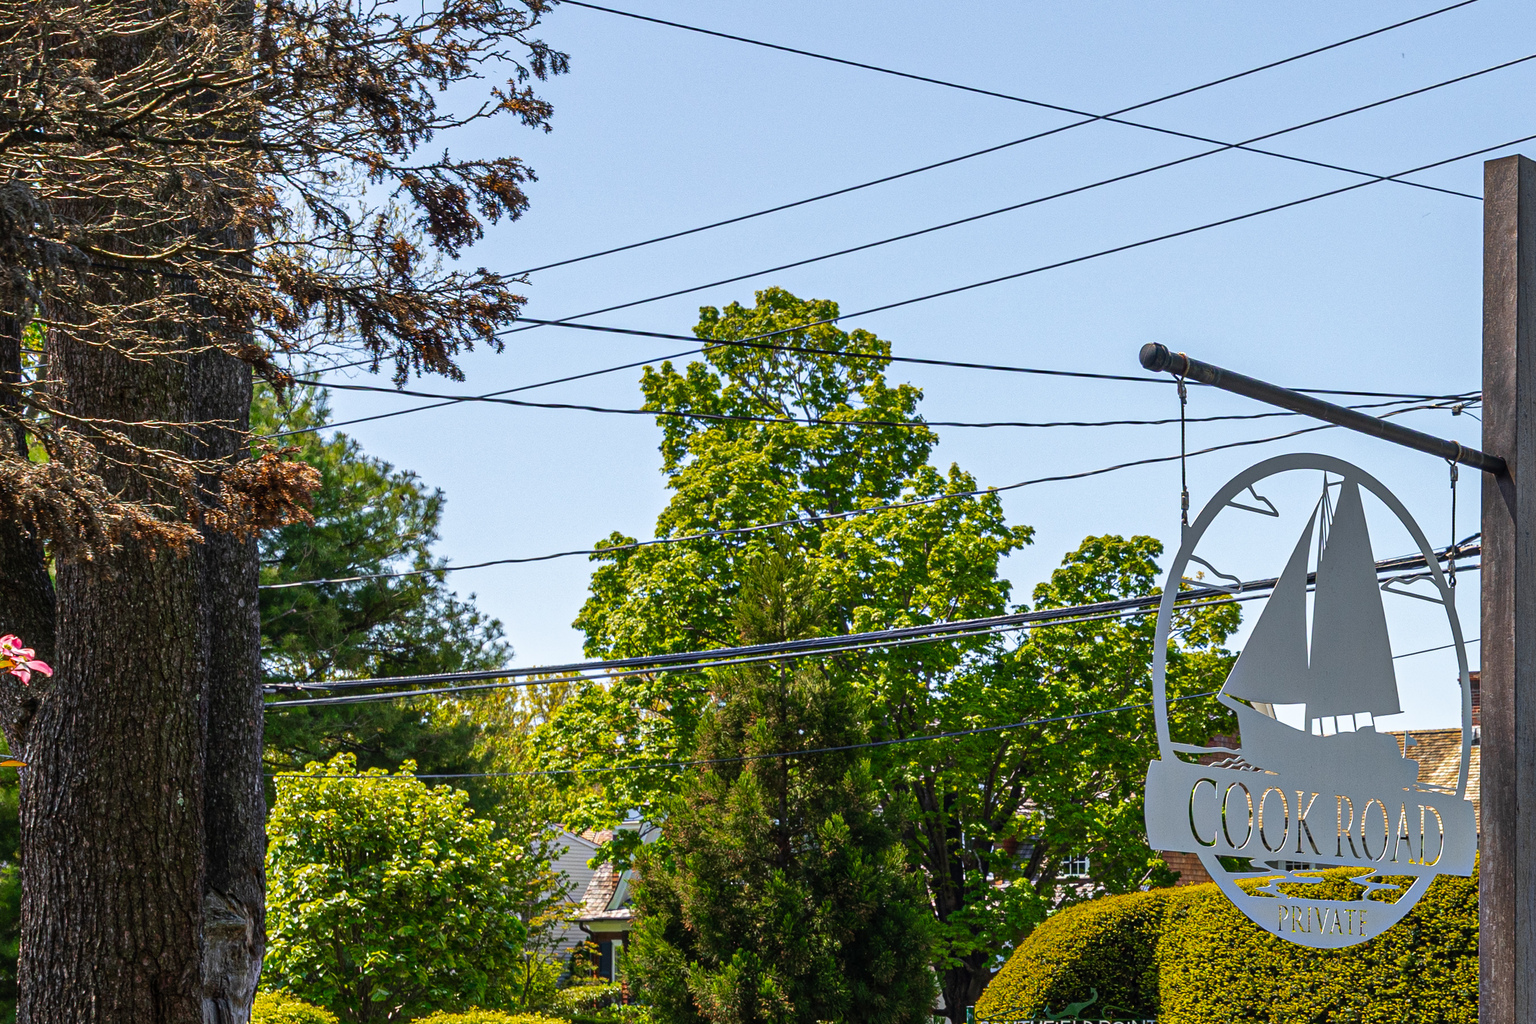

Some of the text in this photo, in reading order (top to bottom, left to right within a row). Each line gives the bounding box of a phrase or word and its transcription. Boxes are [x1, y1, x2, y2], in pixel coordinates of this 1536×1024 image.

[1188, 778, 1445, 867] COOK ROAD
[1277, 904, 1369, 937] PRIVATE
